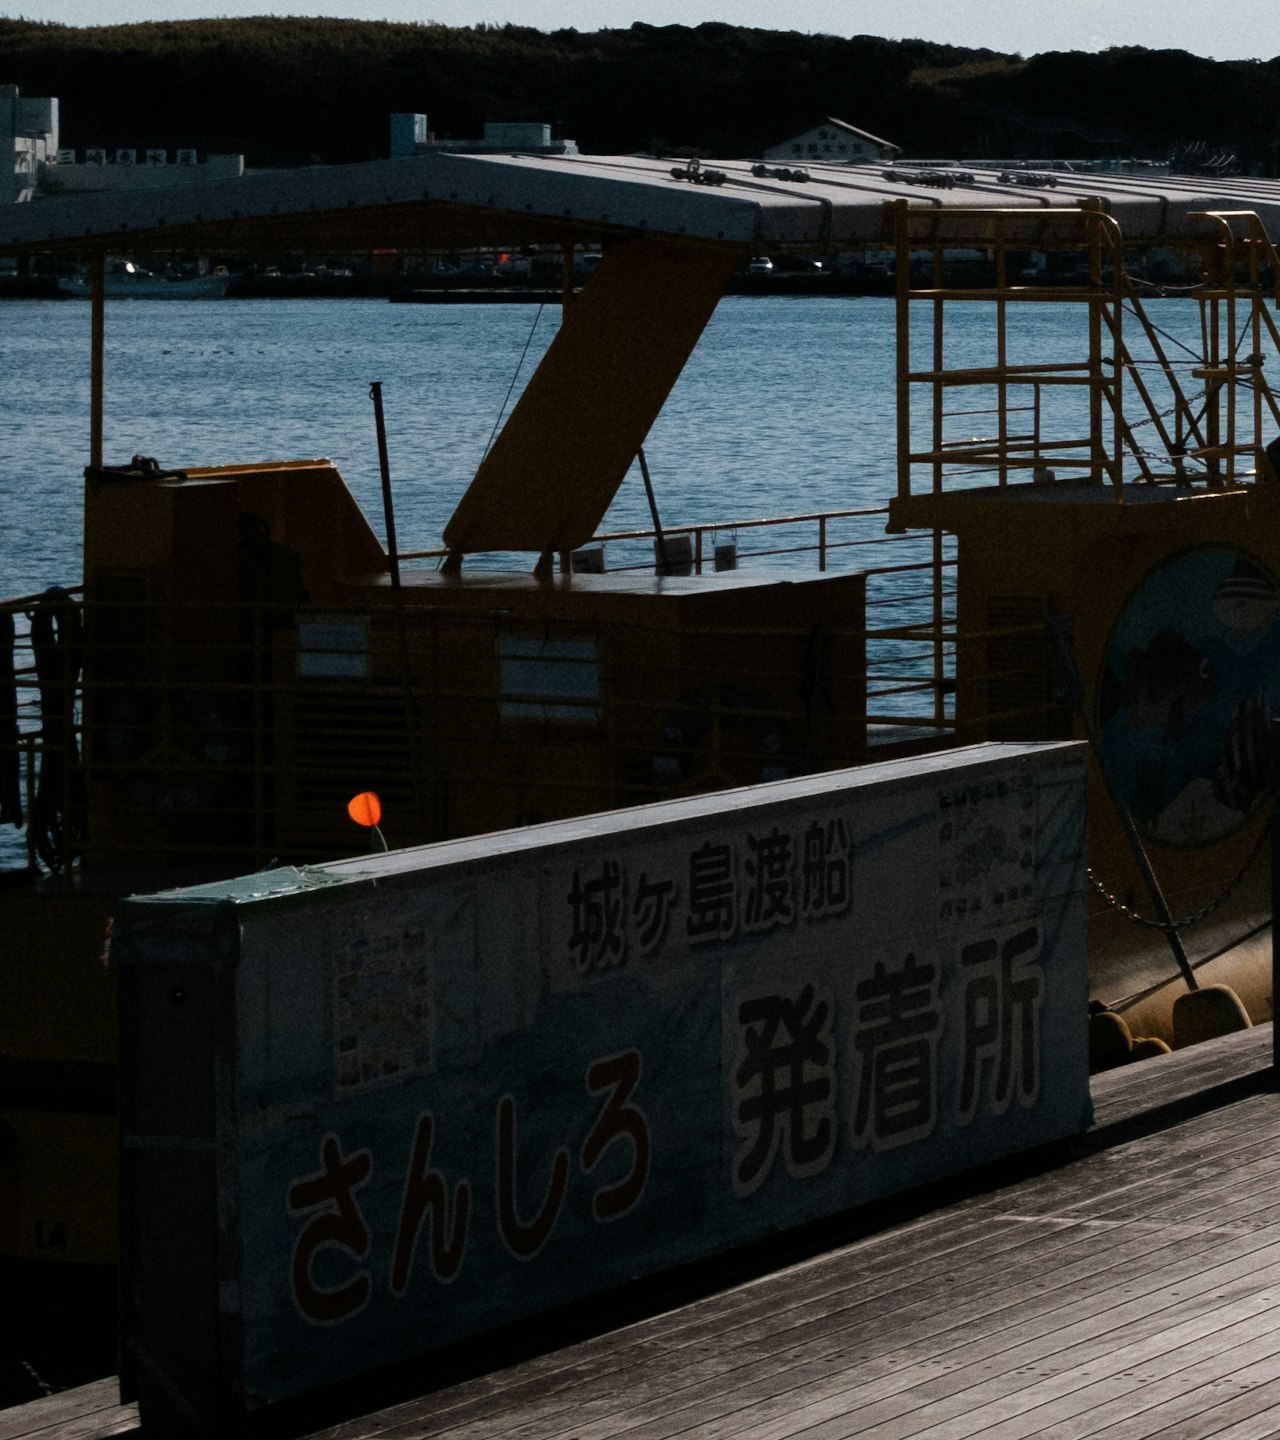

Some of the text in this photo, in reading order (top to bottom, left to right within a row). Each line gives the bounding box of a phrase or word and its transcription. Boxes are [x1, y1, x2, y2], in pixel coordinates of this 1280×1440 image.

[290, 1052, 650, 1322] さんしろ
[733, 930, 1042, 1195] 発着所
